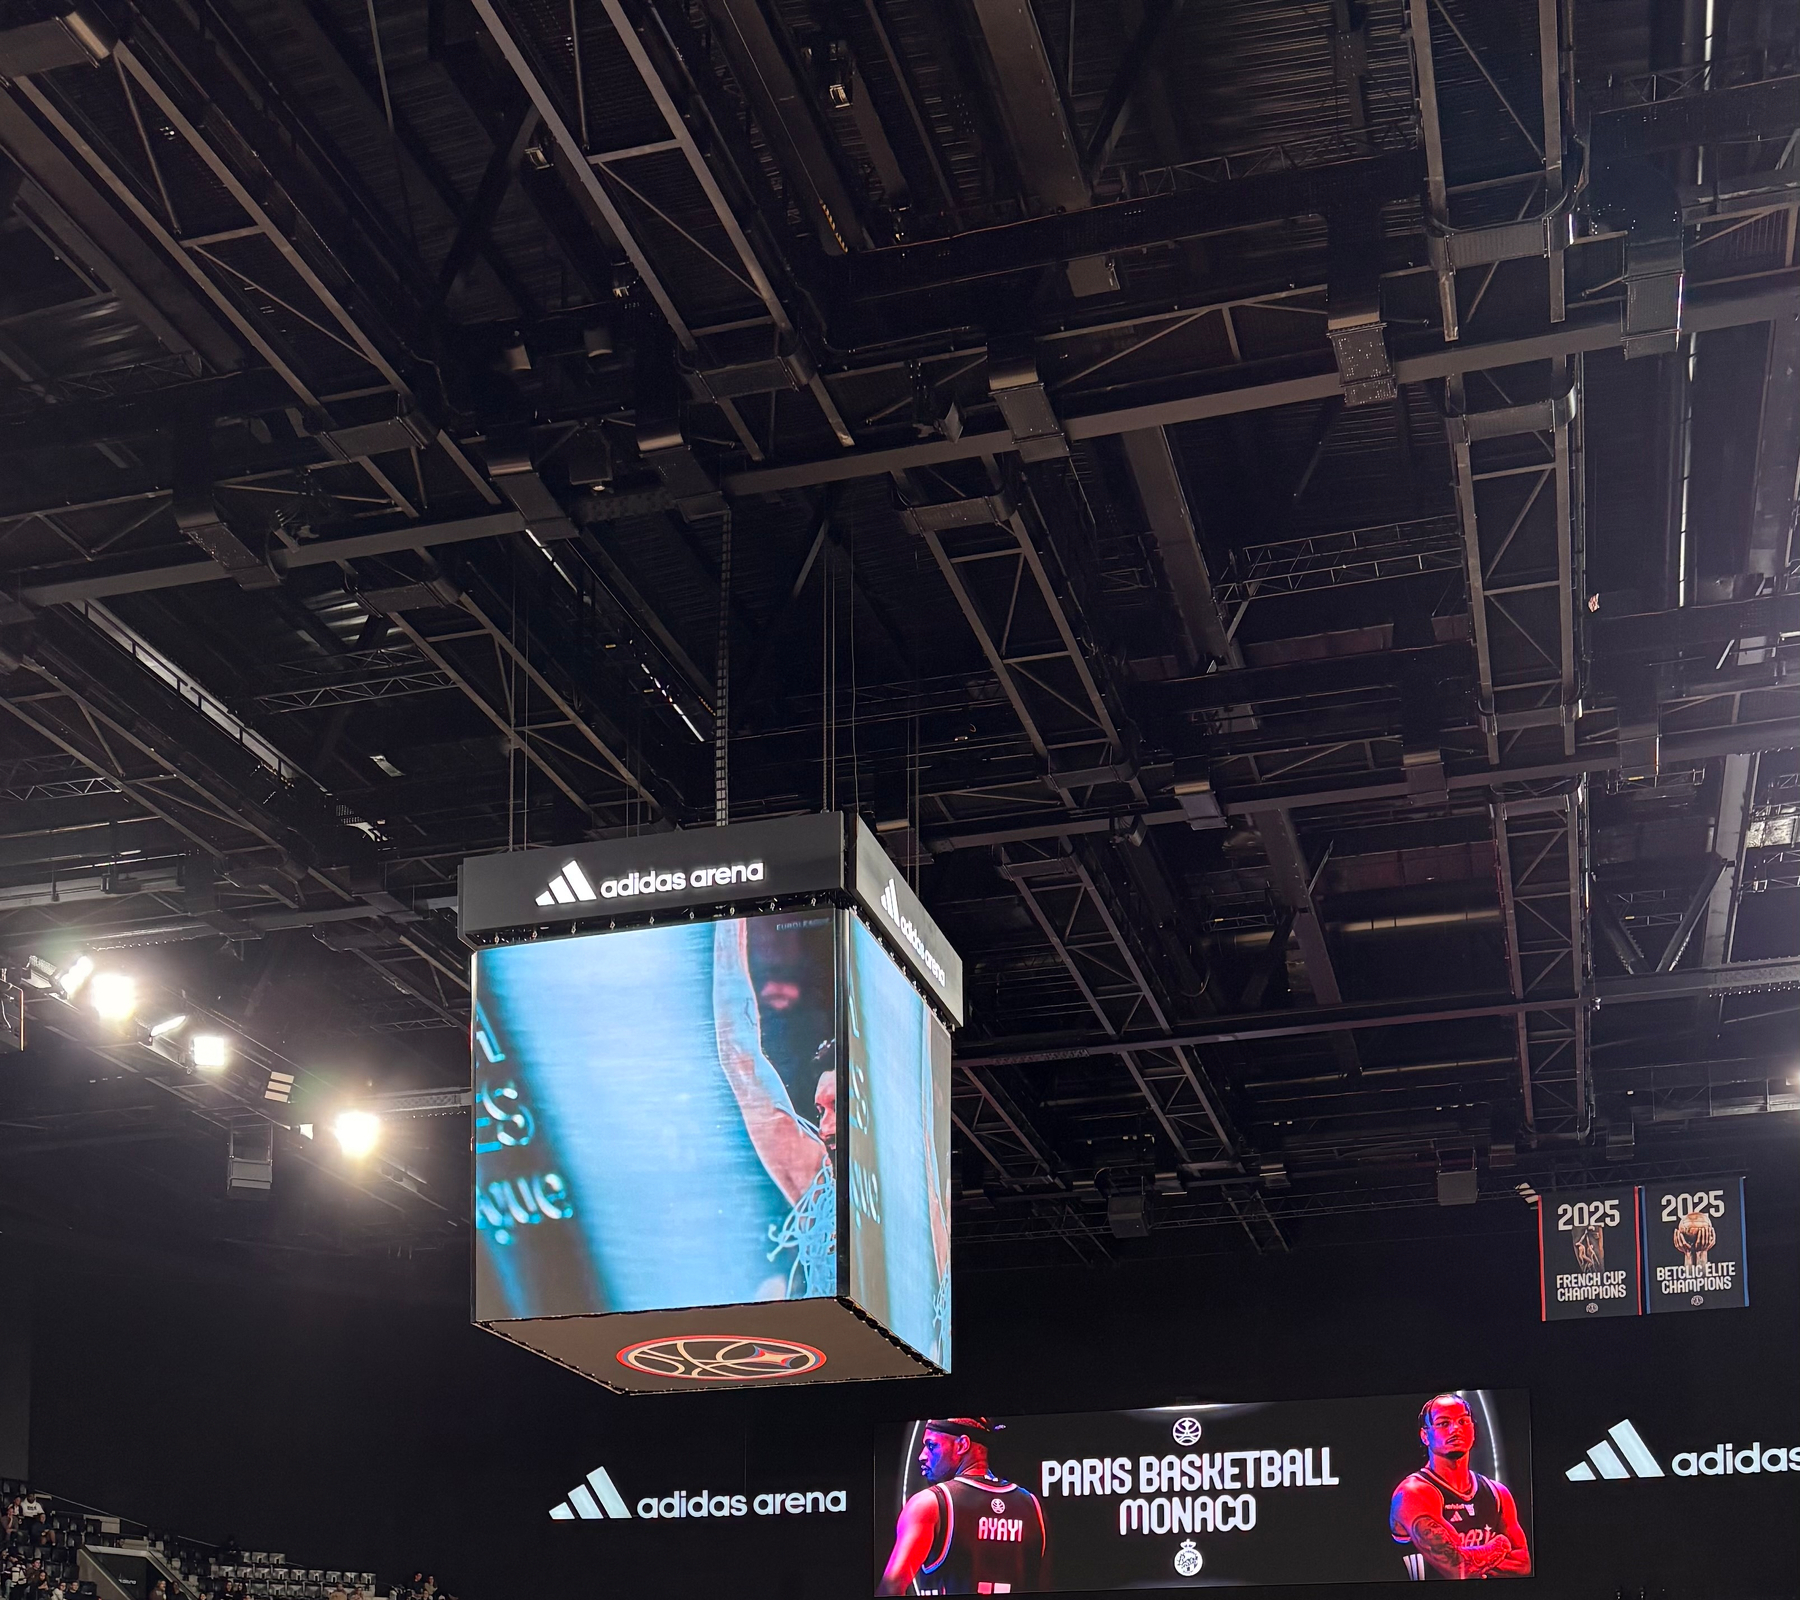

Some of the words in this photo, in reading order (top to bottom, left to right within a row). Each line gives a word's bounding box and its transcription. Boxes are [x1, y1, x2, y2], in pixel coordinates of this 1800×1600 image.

[600, 871, 686, 898] adidas
[690, 862, 763, 888] arena
[900, 916, 925, 960] adidas
[925, 949, 946, 987] arena
[1557, 1199, 1620, 1231] 2025
[1661, 1189, 1725, 1223] 2025
[1556, 1272, 1601, 1288] FRENCH
[1603, 1270, 1627, 1285] CUP
[1656, 1264, 1703, 1281] BETCLIC
[1705, 1261, 1736, 1277] ÉLITE
[1661, 1275, 1732, 1294] CHAMPIONS
[1557, 1284, 1627, 1302] CHAMPIONS
[1041, 1457, 1132, 1497] PARIS
[1139, 1447, 1339, 1493] BASKETBALL
[637, 1490, 748, 1518] adidas
[753, 1490, 846, 1515] arena
[1119, 1494, 1256, 1536] MONACO
[978, 1516, 1023, 1542] AYAYI
